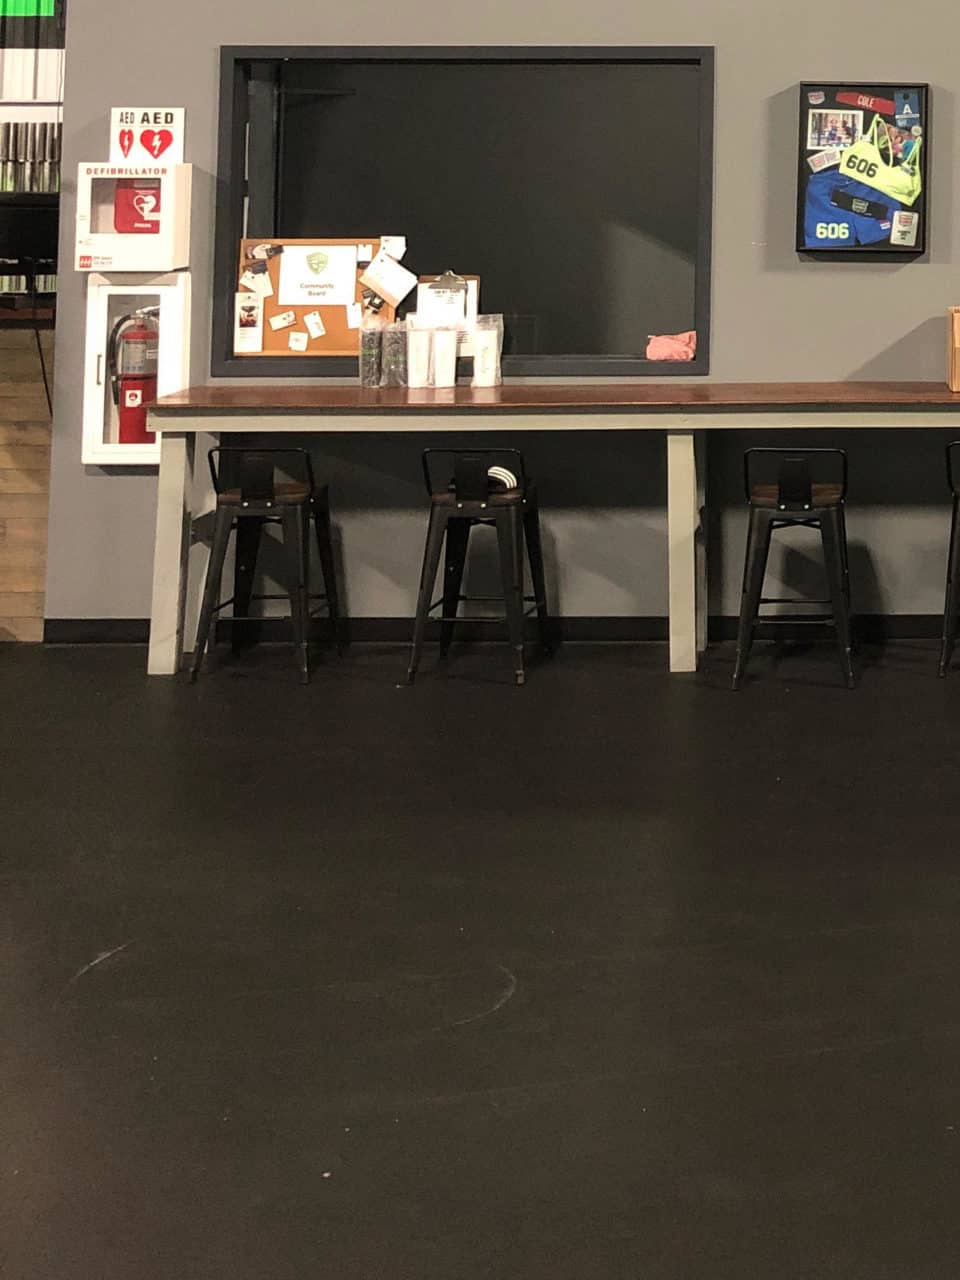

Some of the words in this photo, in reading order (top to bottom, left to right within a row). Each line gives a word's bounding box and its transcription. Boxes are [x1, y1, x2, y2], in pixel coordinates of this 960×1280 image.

[120, 112, 134, 124] AED
[141, 112, 174, 124] AED
[846, 154, 879, 178] 606
[816, 222, 849, 239] 606
